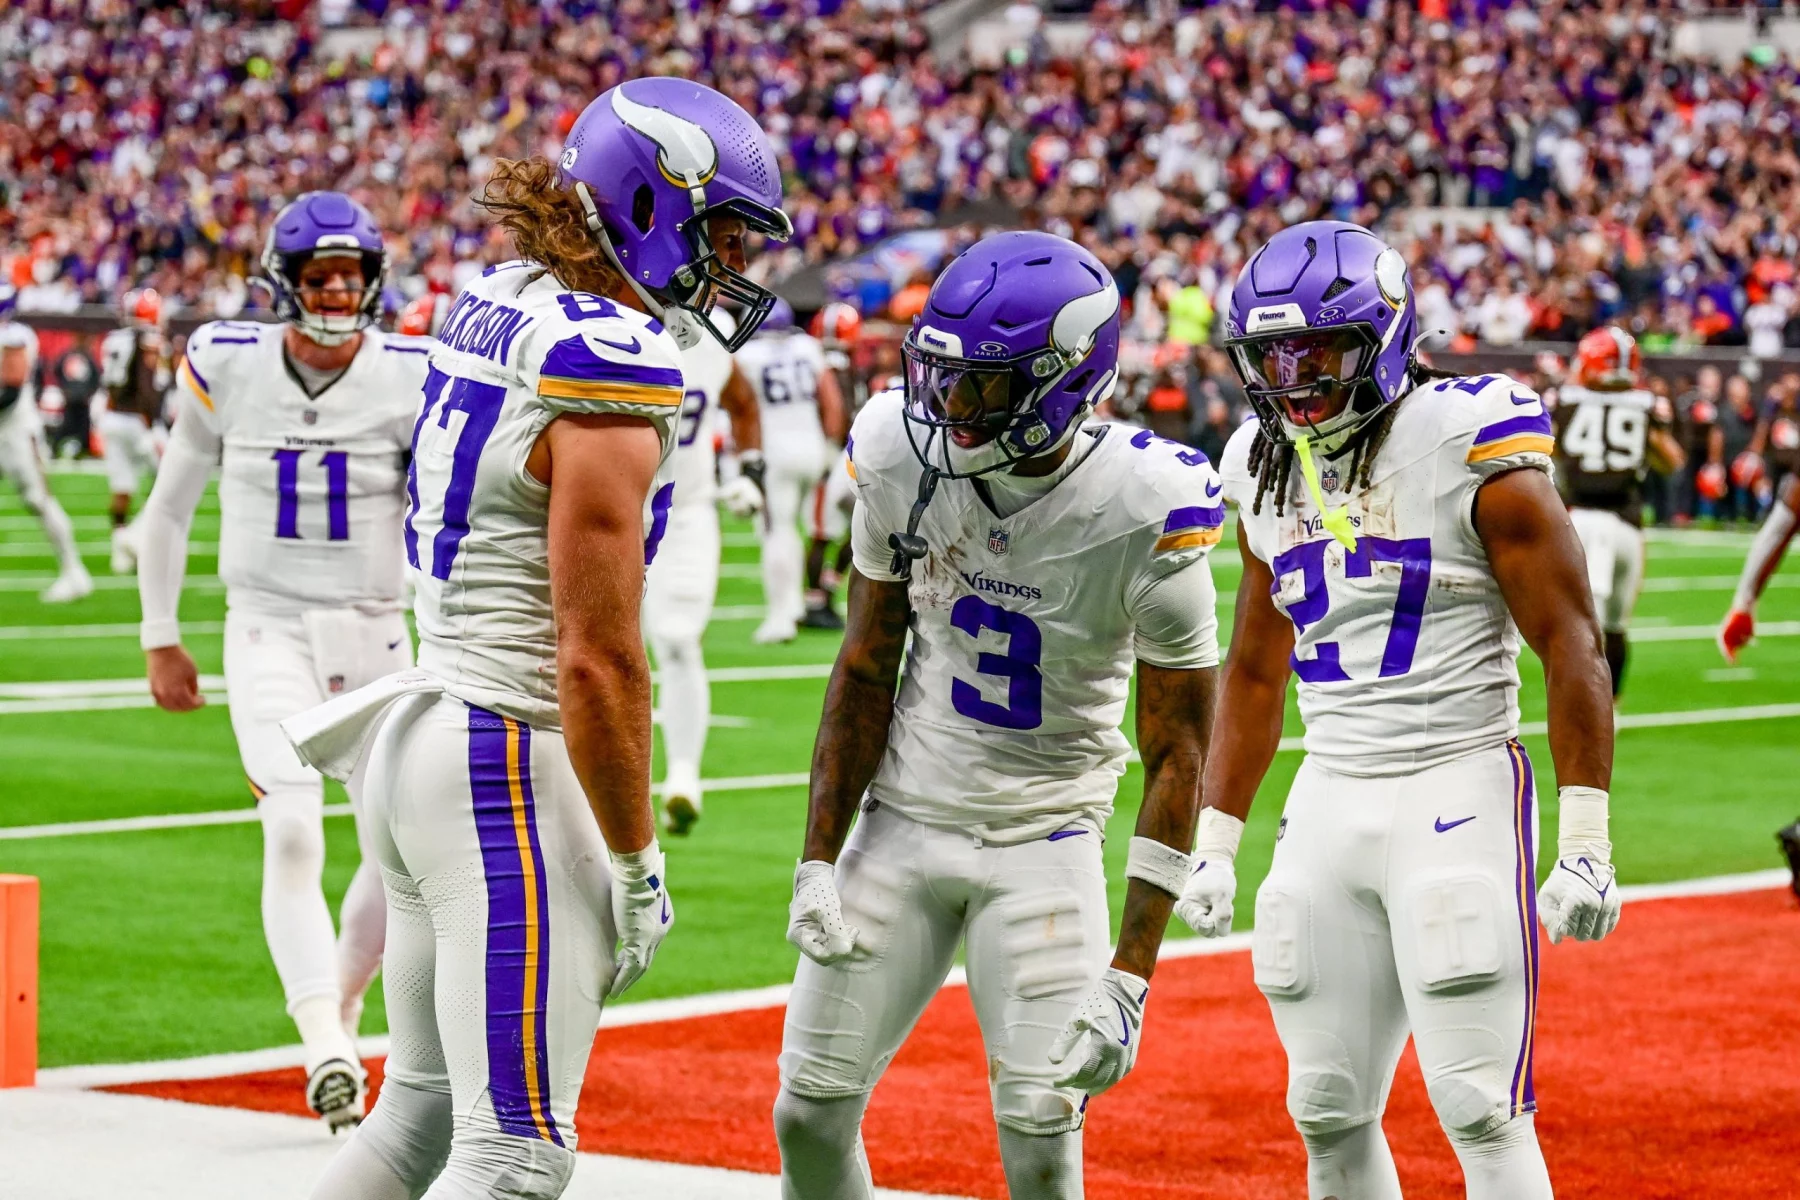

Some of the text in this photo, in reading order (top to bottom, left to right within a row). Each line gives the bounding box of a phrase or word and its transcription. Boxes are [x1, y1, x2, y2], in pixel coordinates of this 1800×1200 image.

[1563, 404, 1648, 472] 49
[270, 448, 349, 541] 11
[960, 570, 1042, 600] VIKINGS
[1270, 537, 1432, 682] 27
[950, 594, 1043, 730] 3
